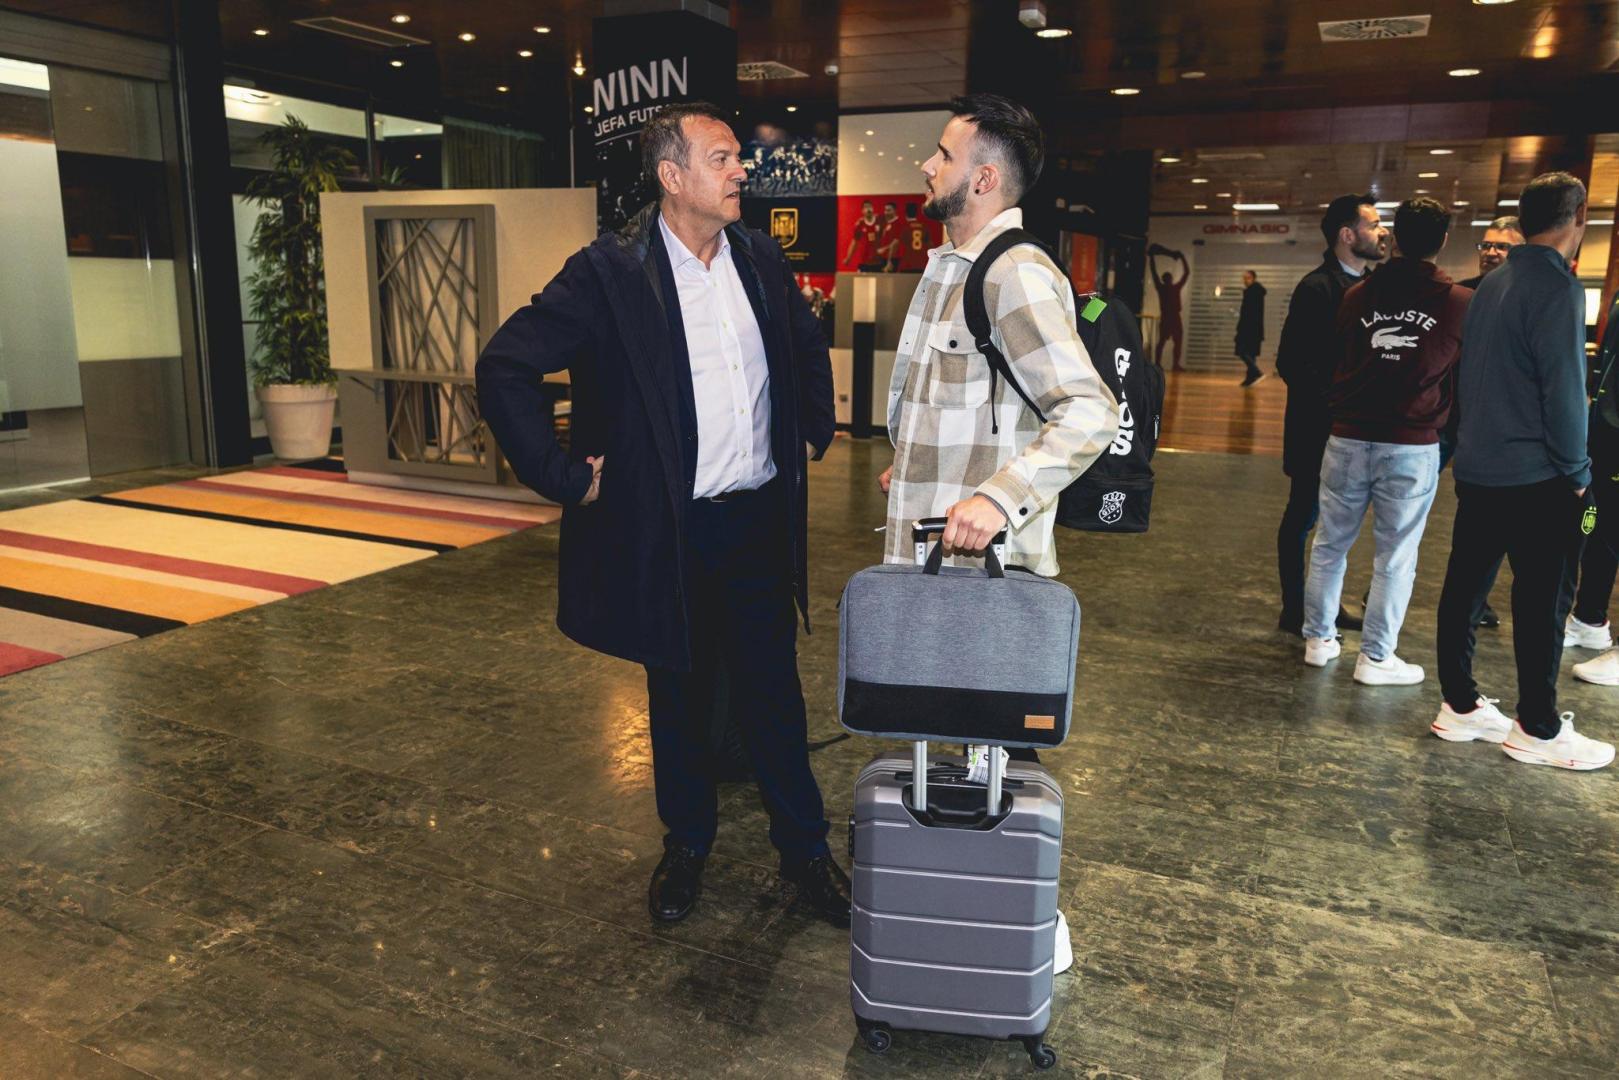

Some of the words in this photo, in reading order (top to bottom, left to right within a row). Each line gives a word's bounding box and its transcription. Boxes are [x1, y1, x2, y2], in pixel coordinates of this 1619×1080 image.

[1203, 224, 1290, 235] GIMNASIO
[911, 229, 923, 251] 8
[1381, 353, 1401, 361] PARIS
[1109, 347, 1135, 456] GOS
